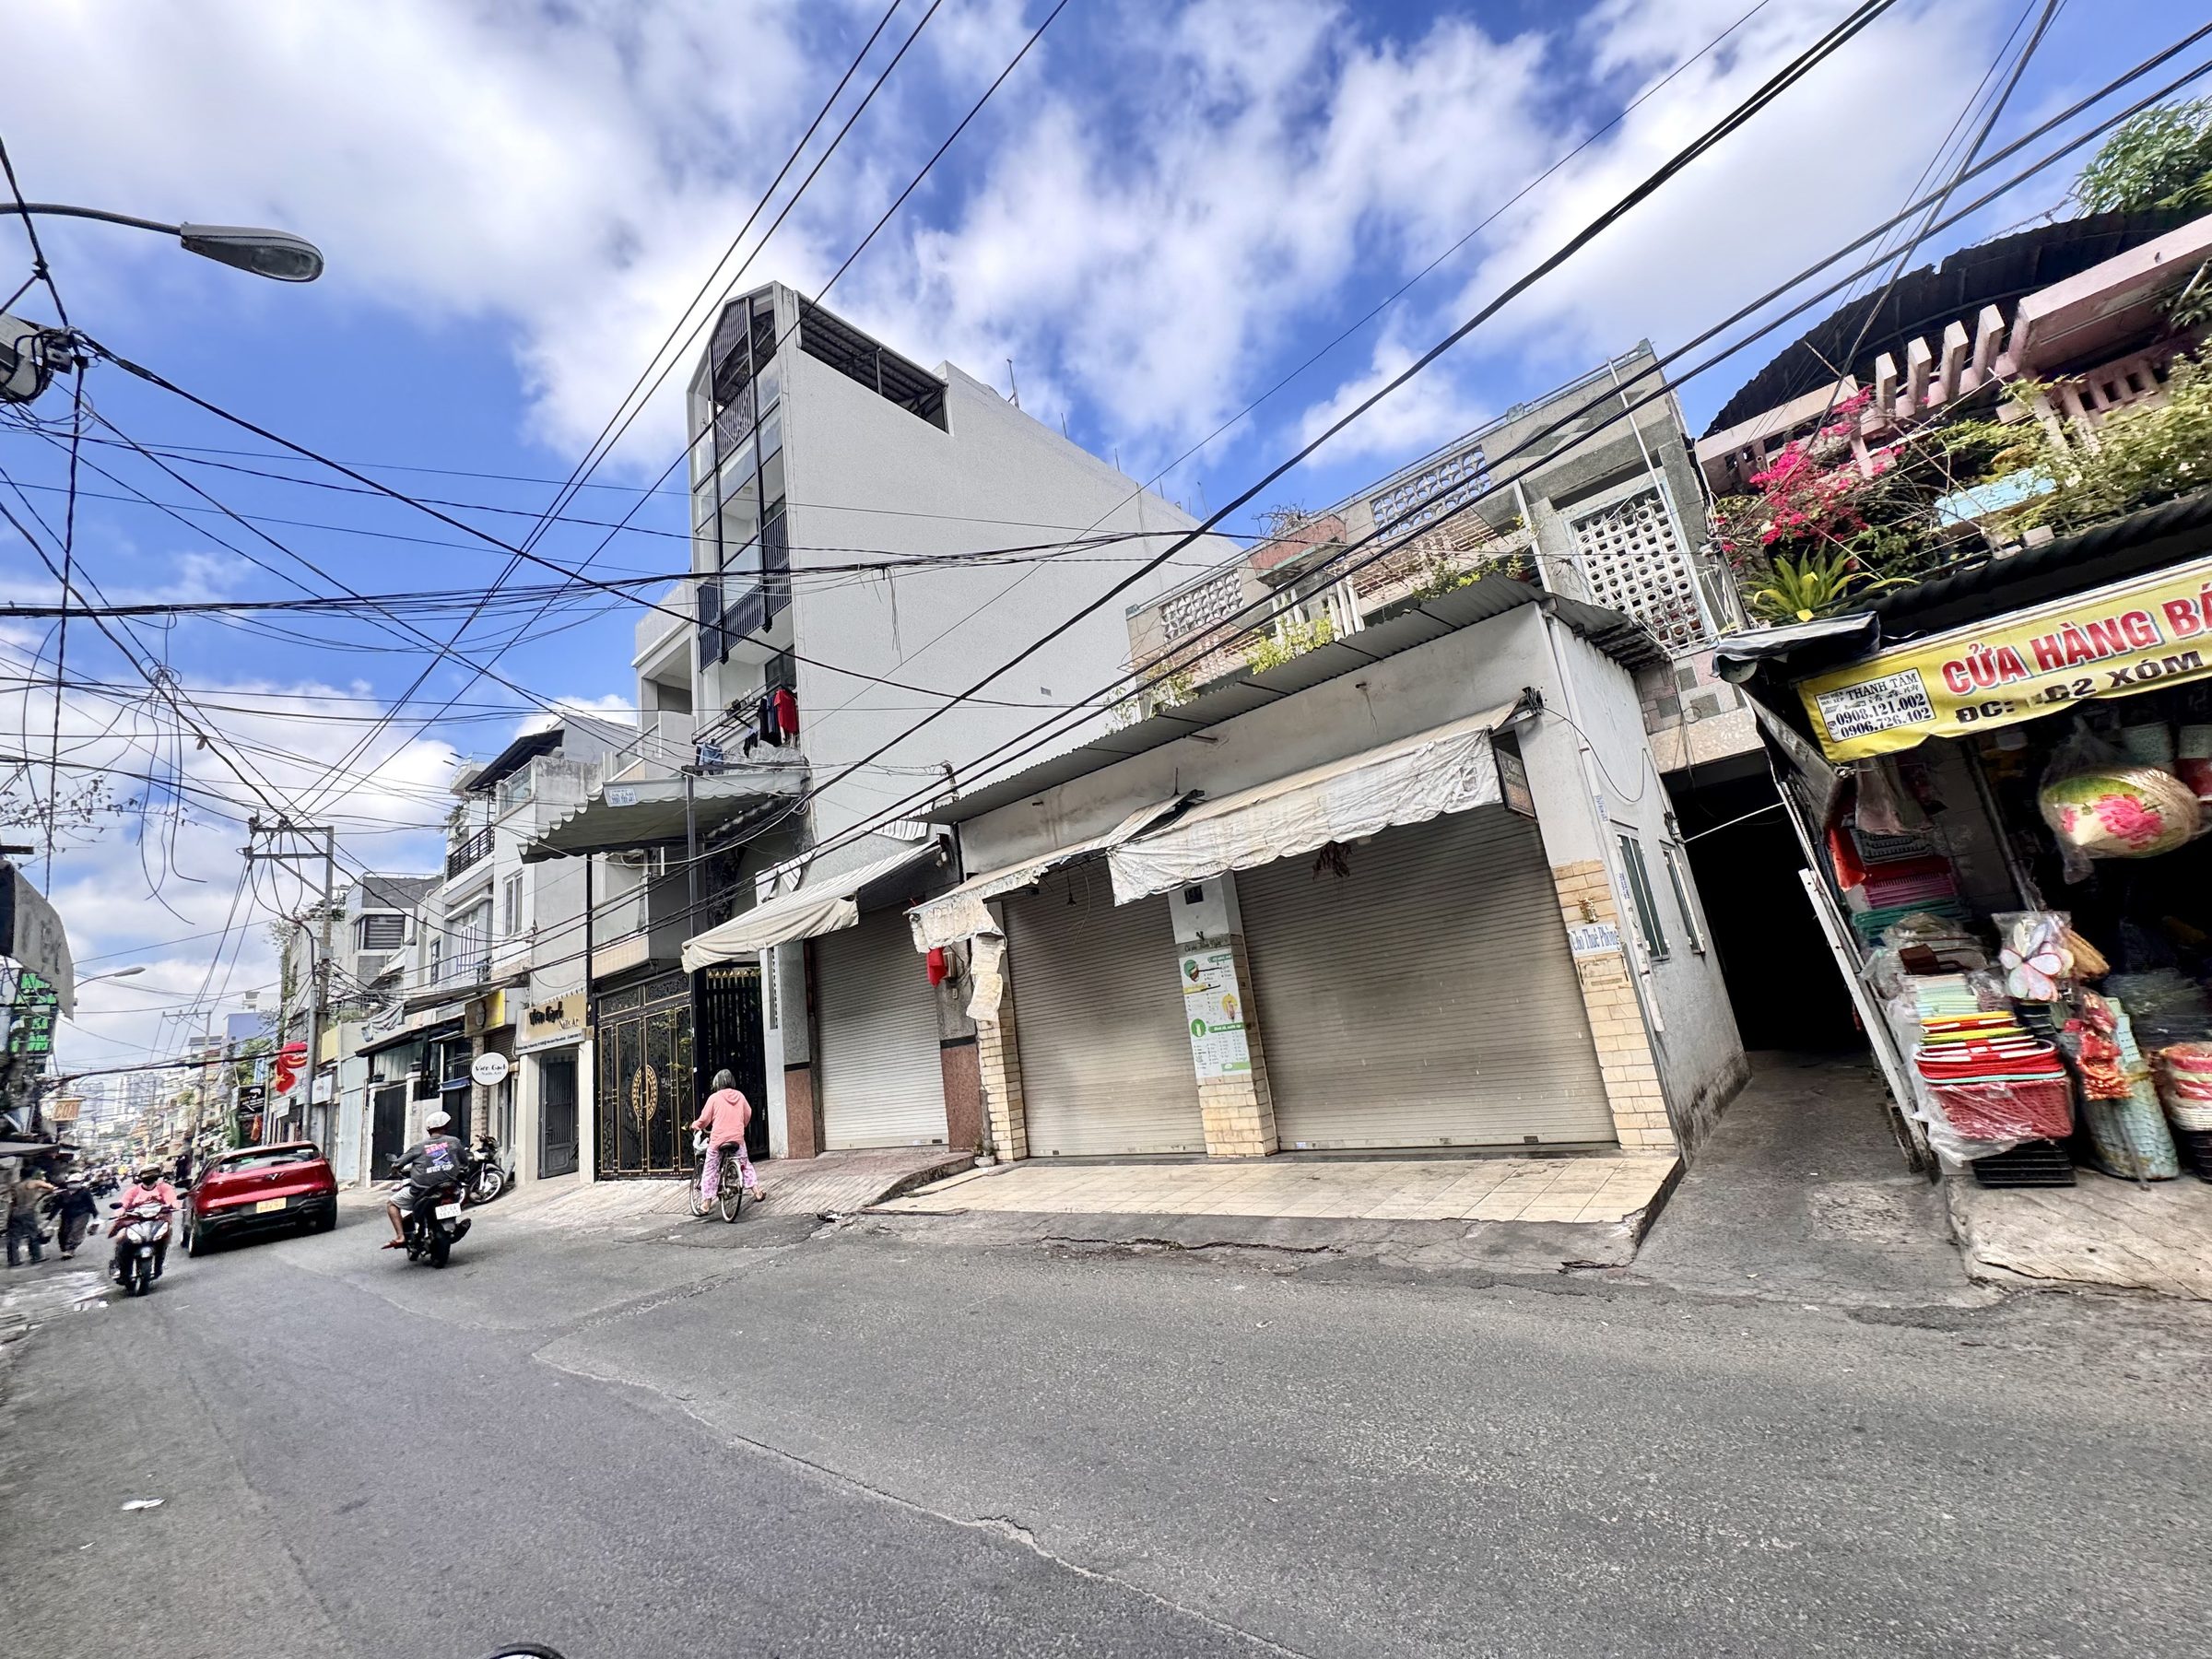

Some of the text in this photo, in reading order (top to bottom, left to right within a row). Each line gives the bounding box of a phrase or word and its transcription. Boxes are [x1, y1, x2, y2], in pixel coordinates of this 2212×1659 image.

[1942, 642, 2028, 693] CỬA
[2030, 611, 2159, 671] HÀNG
[1846, 681, 1888, 700] THANH
[1889, 673, 1918, 688] TÂM
[1955, 700, 2016, 724] ĐC:
[2107, 651, 2204, 688] XÓM
[1836, 693, 1926, 725] 0908.121.002
[1841, 707, 1931, 737] 0906.726.402
